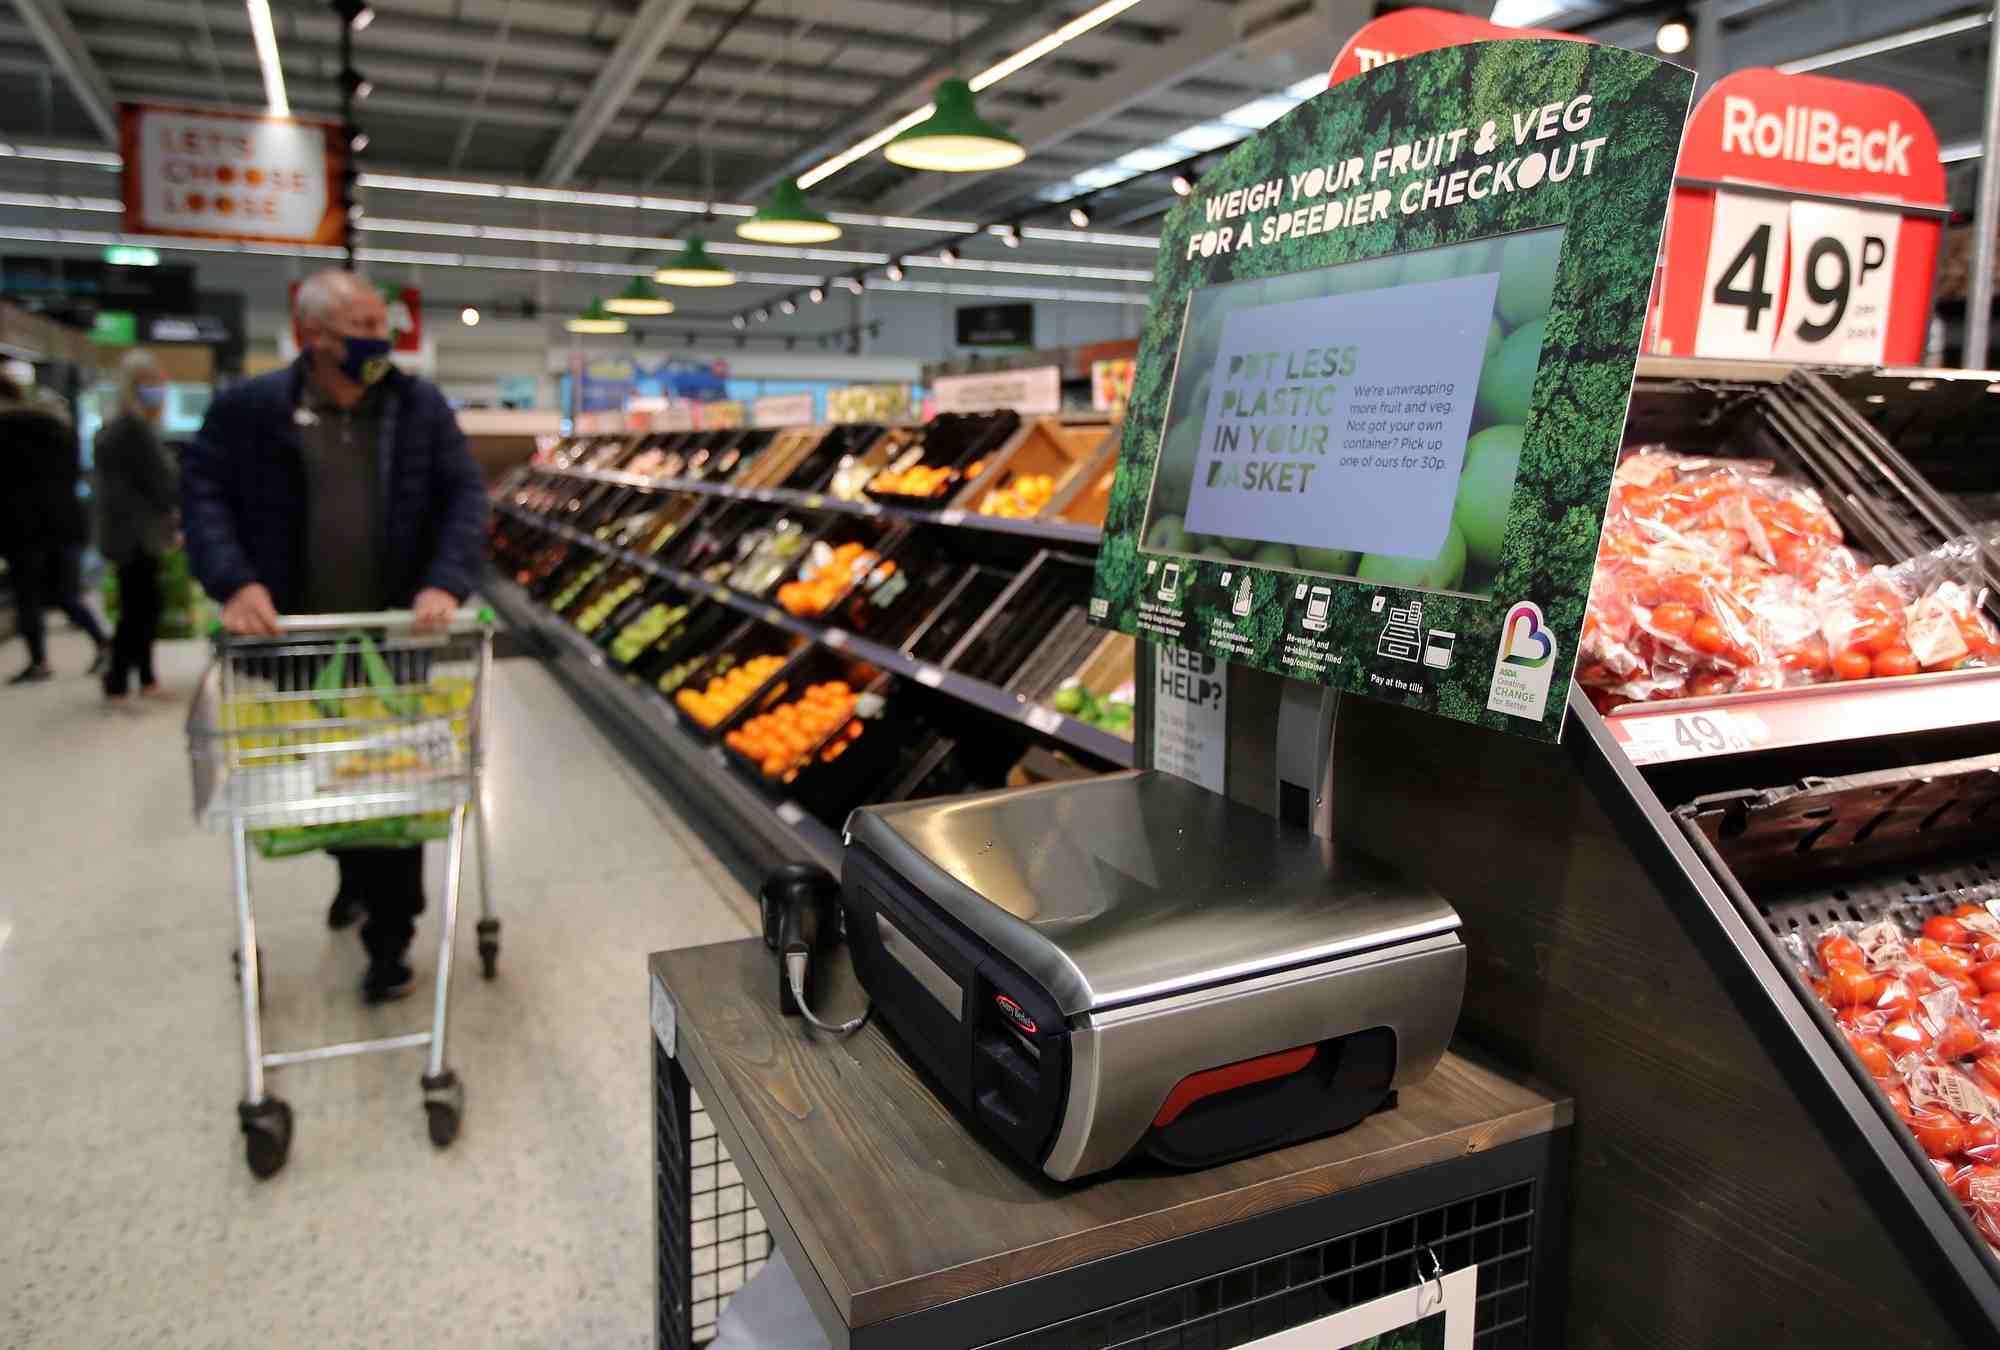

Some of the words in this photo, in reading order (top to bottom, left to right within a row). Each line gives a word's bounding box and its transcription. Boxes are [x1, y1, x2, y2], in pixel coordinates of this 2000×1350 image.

[1721, 95, 1914, 176] RollBack
[1206, 178, 1283, 223] WEIGH
[1291, 157, 1364, 202] YOUR
[1371, 128, 1467, 182] FRUIT
[1473, 120, 1498, 155] &
[1513, 95, 1593, 146] VEG
[1186, 227, 1233, 261] FOR
[1236, 222, 1254, 250] A
[1260, 189, 1392, 245] SPEEDIER
[1400, 137, 1607, 215] CHECKOUT
[1286, 346, 1357, 380] LESS
[1353, 385, 1385, 398] We're
[1386, 382, 1456, 398] unwrapping
[1219, 383, 1337, 418] PLASTIC
[1349, 403, 1377, 414] more
[1379, 401, 1402, 414] fruit
[1404, 401, 1427, 413] and
[1345, 420, 1366, 432] Not
[1367, 420, 1388, 434] got
[1389, 421, 1416, 434] your
[1416, 421, 1443, 432] own
[1213, 424, 1241, 452] IN
[1249, 422, 1330, 455] YOUR
[1342, 438, 1399, 449] container?
[1400, 438, 1425, 449] Pick
[1426, 440, 1443, 452] up
[1339, 457, 1360, 467] one
[1360, 456, 1373, 467] of
[1374, 457, 1399, 468] ours
[1399, 456, 1419, 469] for
[1316, 641, 1330, 650] and
[1160, 642, 1216, 675] NEED
[1282, 655, 1326, 673] bag/container
[1308, 650, 1324, 660] your
[1324, 653, 1343, 665] filled
[1159, 669, 1223, 711] HELP?
[1370, 673, 1384, 686] Pay
[1385, 678, 1394, 687] at
[1395, 679, 1408, 690] the
[1409, 682, 1424, 694] tills
[1495, 686, 1537, 704] CHANGE
